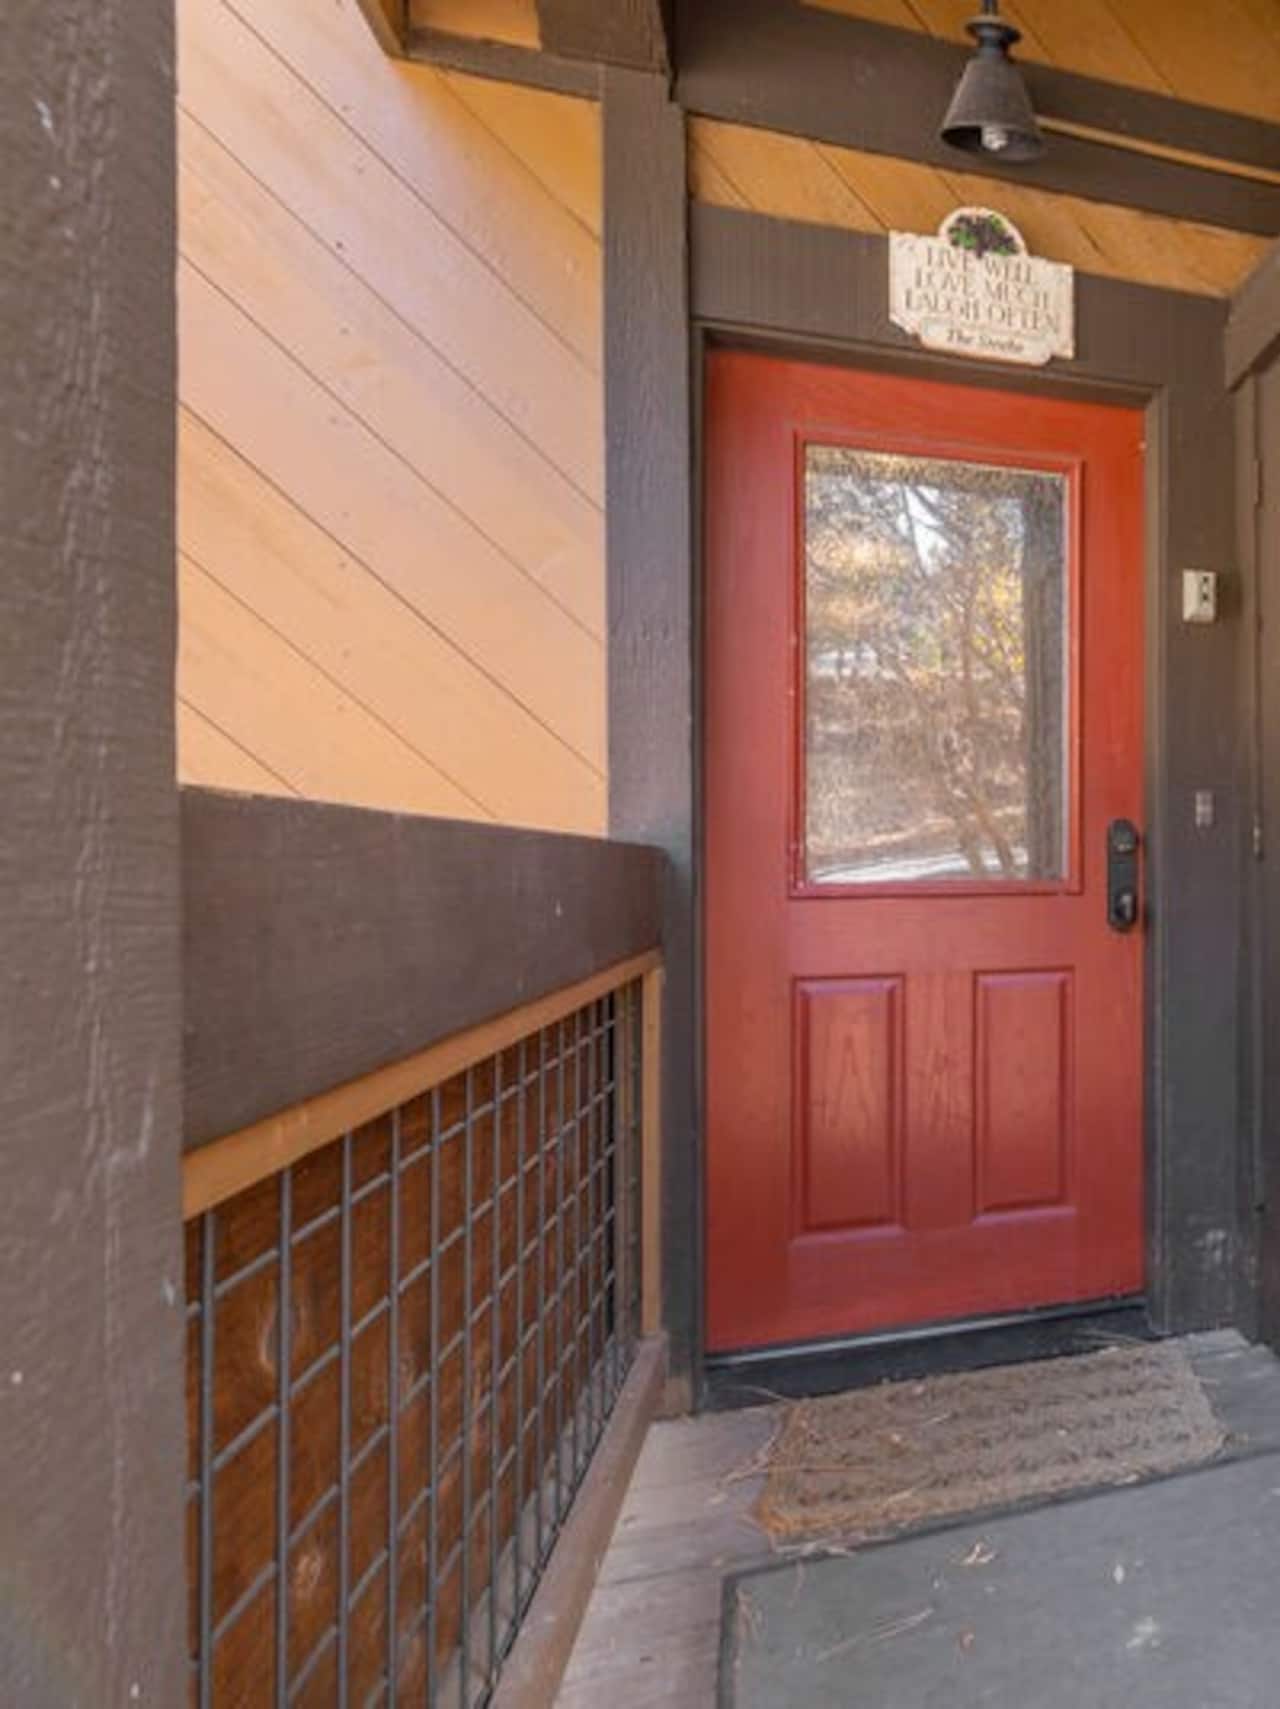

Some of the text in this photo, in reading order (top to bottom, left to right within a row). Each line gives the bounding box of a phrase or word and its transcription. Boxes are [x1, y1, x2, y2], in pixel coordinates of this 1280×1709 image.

[927, 247, 1039, 285] LIVE WELL
[905, 289, 1060, 333] LAUGH OFTEN
[916, 269, 1048, 311] LOVE MUCH
